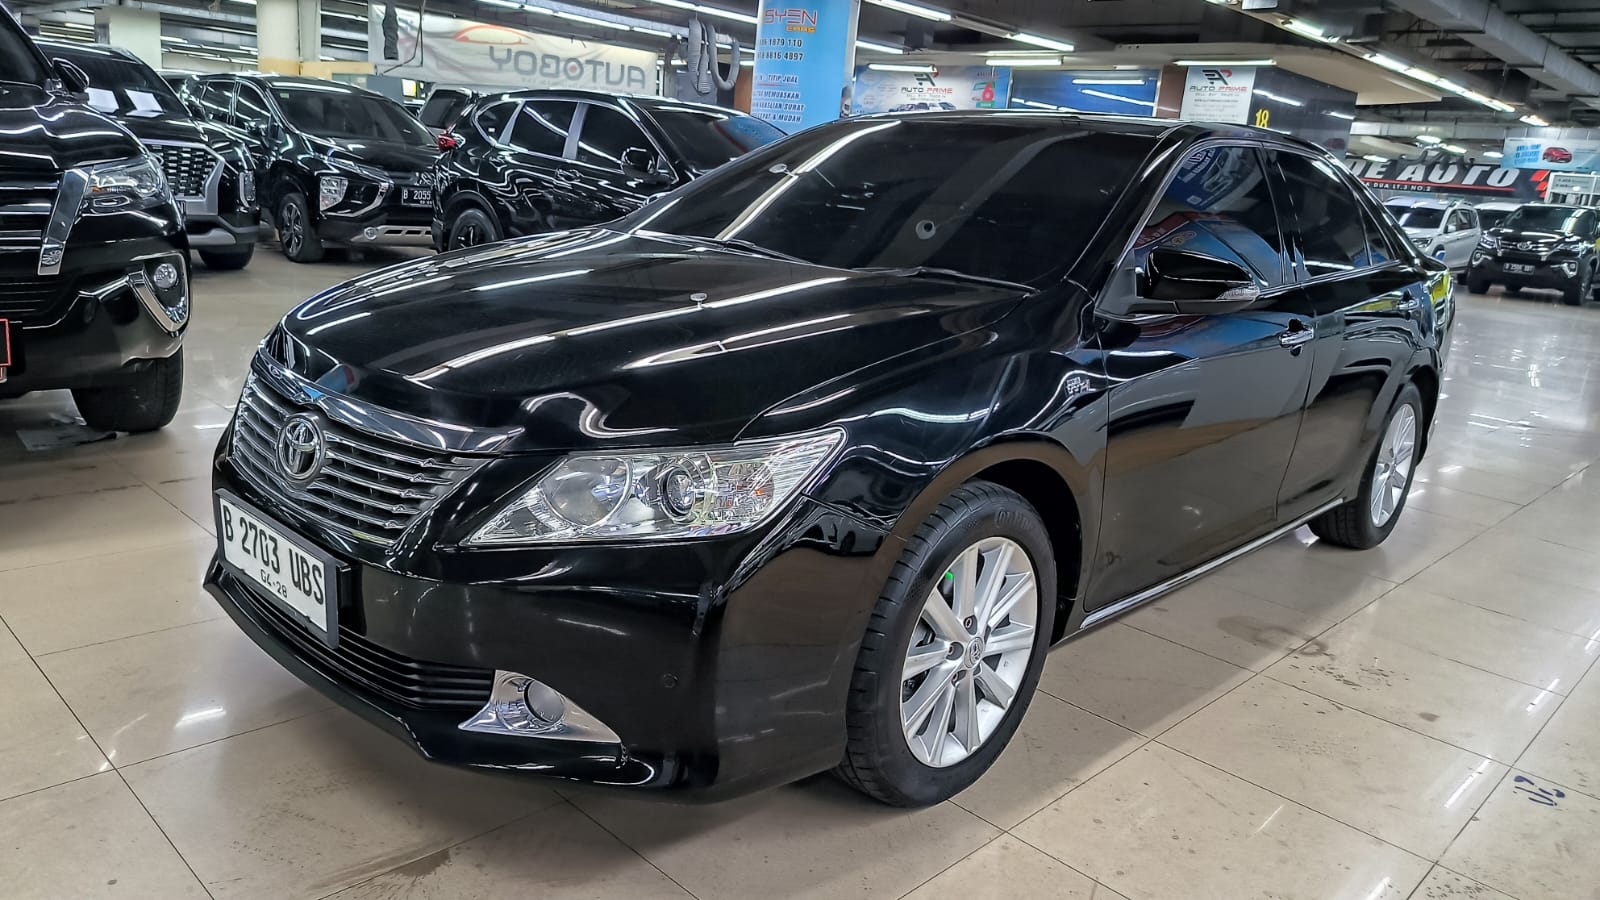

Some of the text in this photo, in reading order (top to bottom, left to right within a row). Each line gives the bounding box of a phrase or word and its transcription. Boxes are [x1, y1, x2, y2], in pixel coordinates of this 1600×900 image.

[1256, 109, 1270, 128] 18
[1396, 163, 1520, 188] AUTO
[403, 189, 409, 200] B
[222, 504, 324, 606] B 2703 UBS
